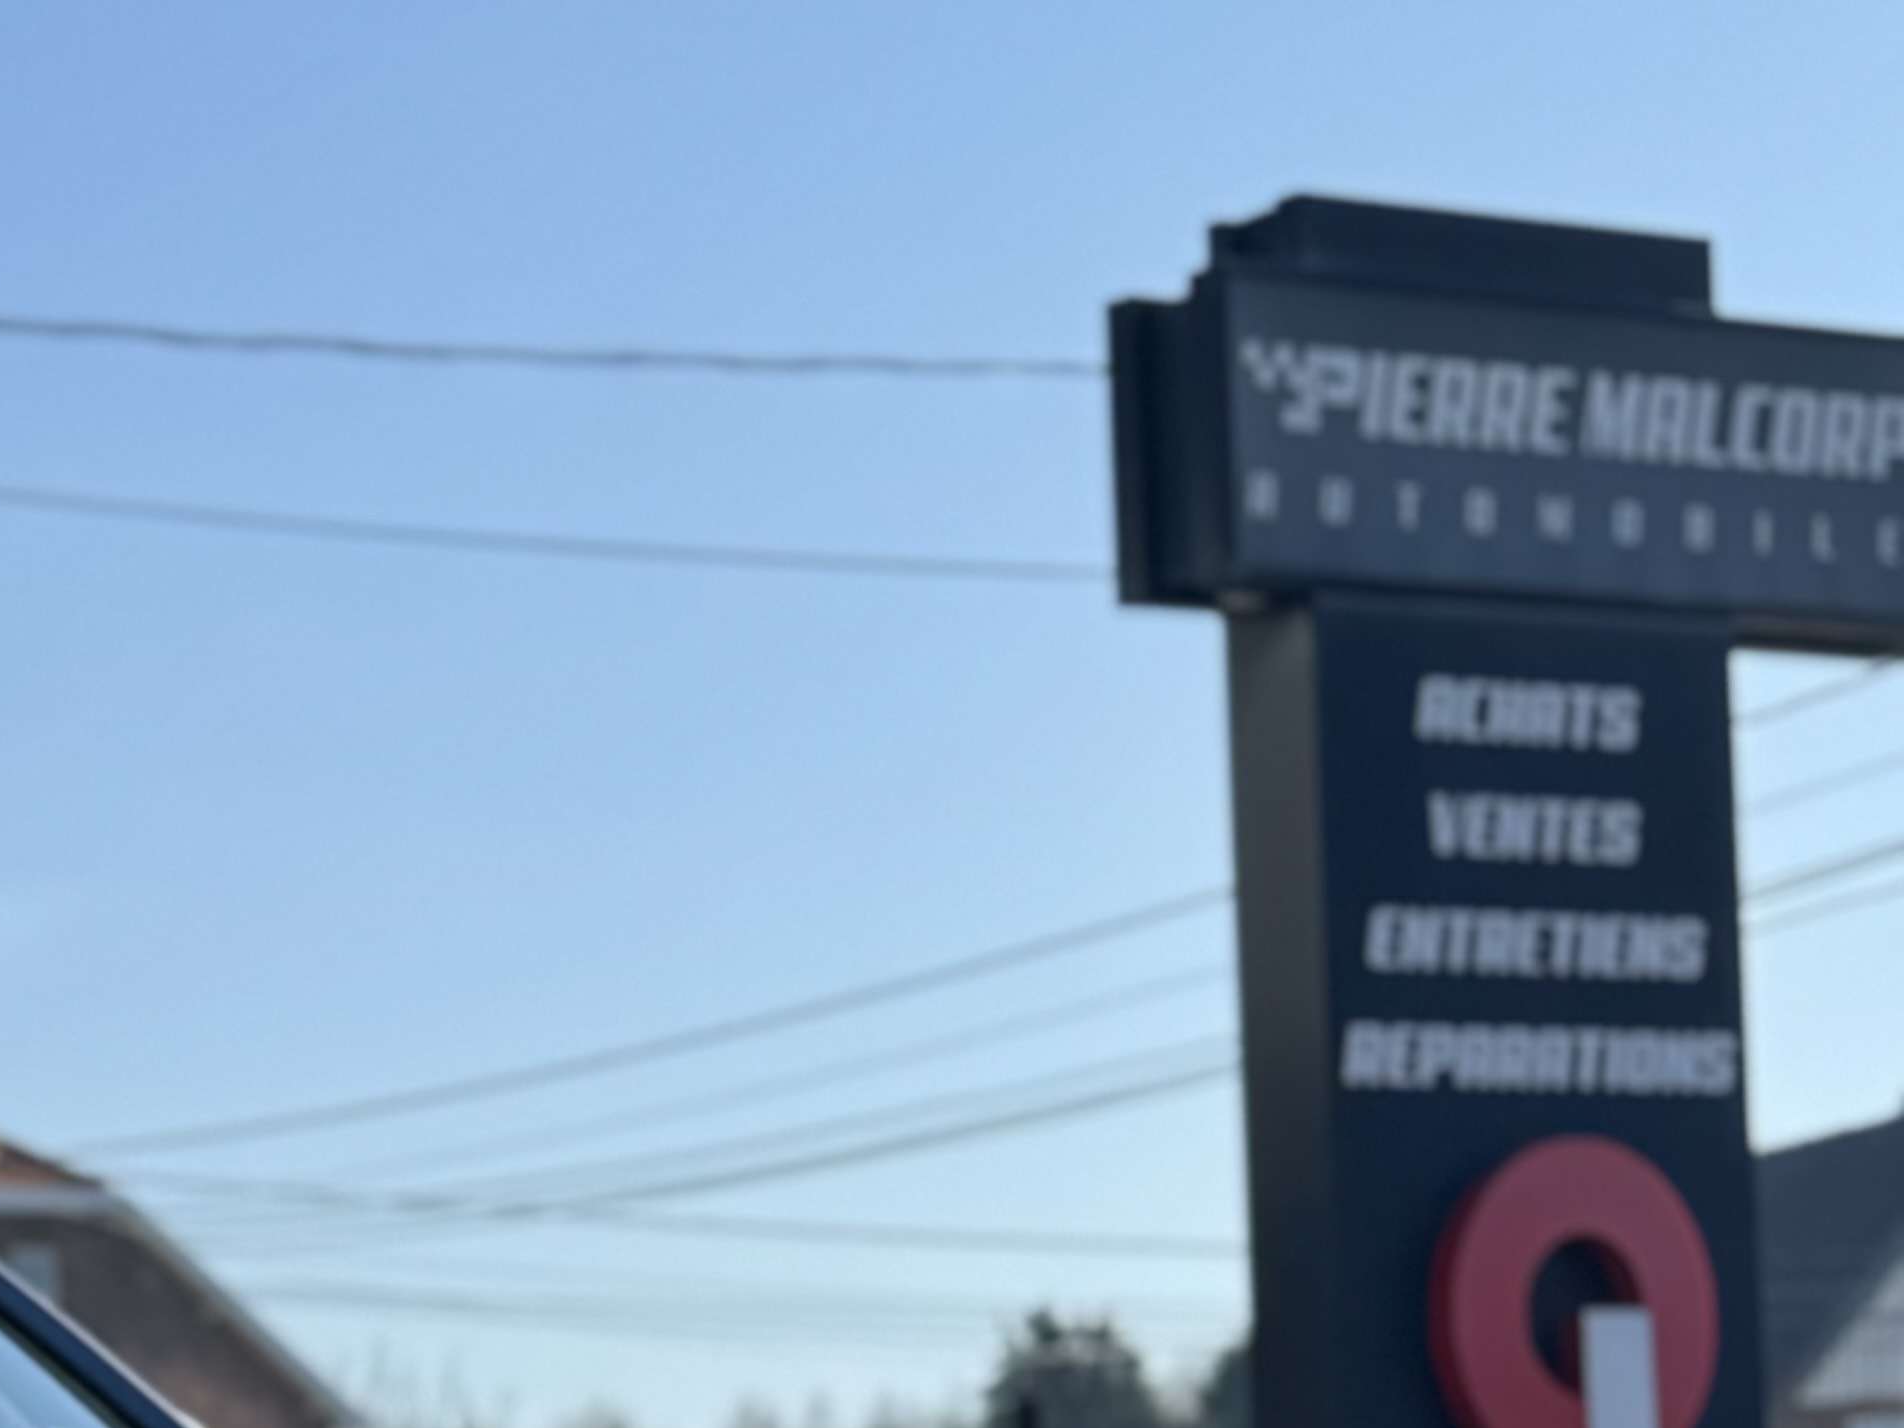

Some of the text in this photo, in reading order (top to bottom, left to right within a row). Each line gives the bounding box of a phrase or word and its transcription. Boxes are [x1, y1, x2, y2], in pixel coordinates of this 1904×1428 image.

[1280, 342, 1575, 456] PIERRE
[1414, 674, 1641, 752] ACHATS
[1426, 790, 1642, 866] VENTES
[1363, 903, 1709, 984] ENTRETIENS
[1339, 1018, 1739, 1096] REPARATIONS
